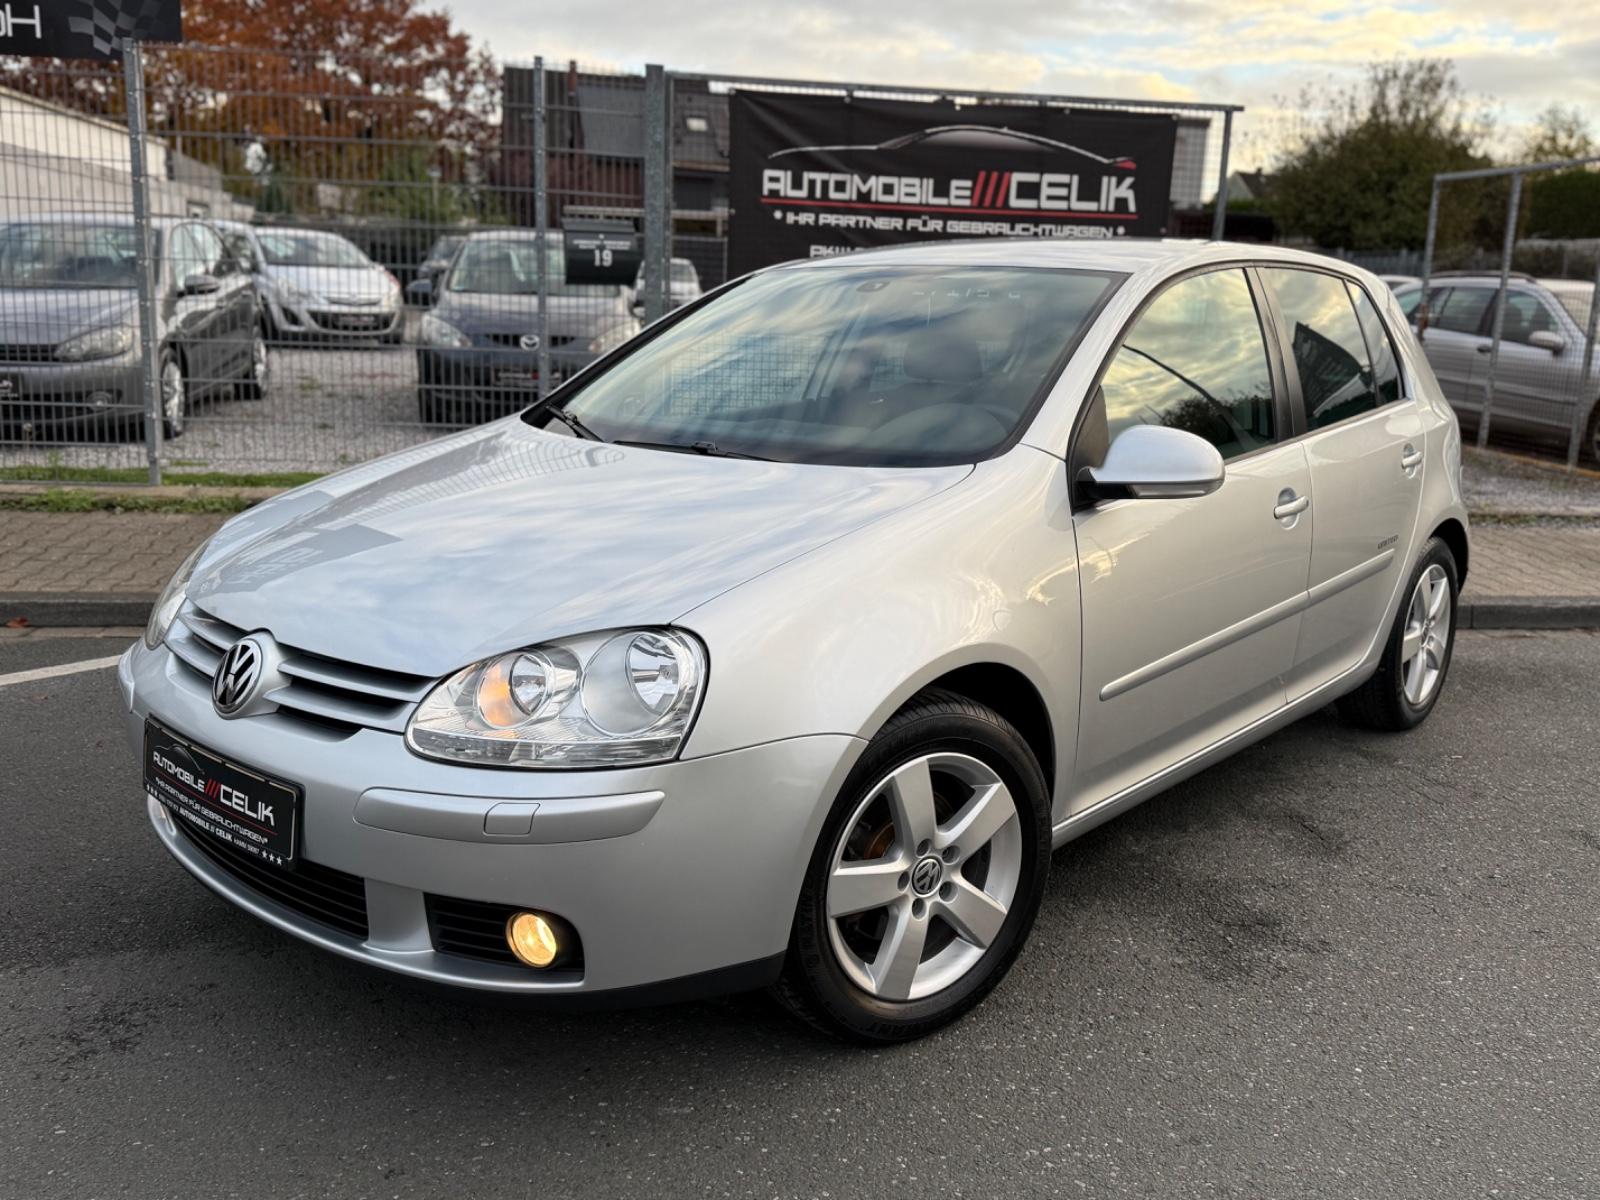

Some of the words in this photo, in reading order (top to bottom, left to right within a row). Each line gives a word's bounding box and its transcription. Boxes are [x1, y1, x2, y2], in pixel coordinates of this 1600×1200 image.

[0, 3, 42, 38] H
[1009, 171, 1136, 213] CELIK
[786, 211, 815, 225] IHR
[818, 213, 903, 230] PARTNER
[906, 215, 943, 232] FÜR
[947, 220, 1113, 238] GEBRAUCHTWAGEN
[594, 249, 613, 267] 19
[220, 785, 274, 826] CELIK
